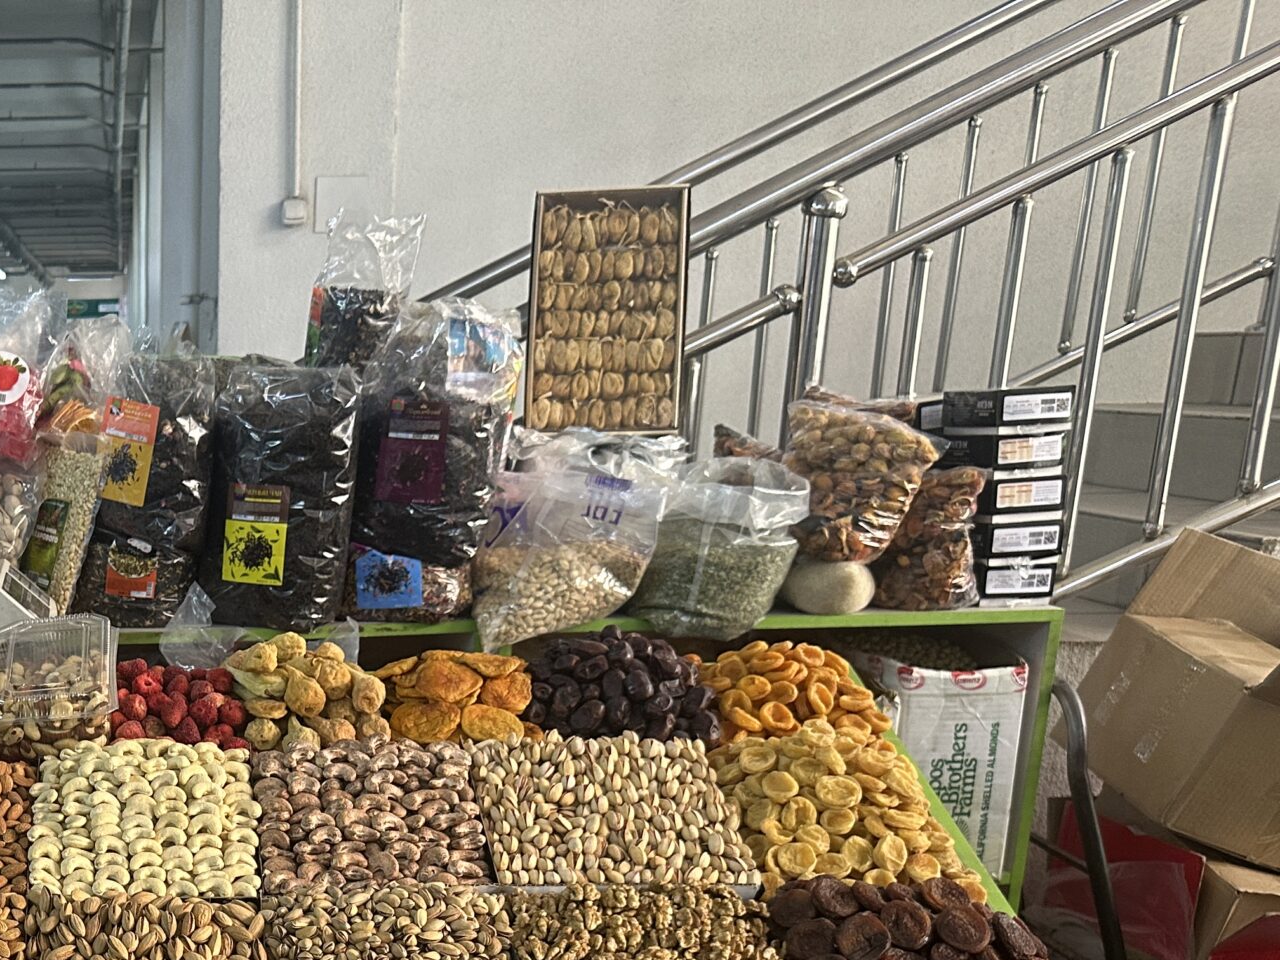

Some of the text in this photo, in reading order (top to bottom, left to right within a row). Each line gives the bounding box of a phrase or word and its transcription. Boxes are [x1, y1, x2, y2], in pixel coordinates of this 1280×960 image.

[929, 758, 945, 800] pos
[941, 722, 968, 805] Brothers
[952, 757, 978, 819] Farms
[976, 721, 1001, 863] ALIFORNIA SHELLED ALMONDS
